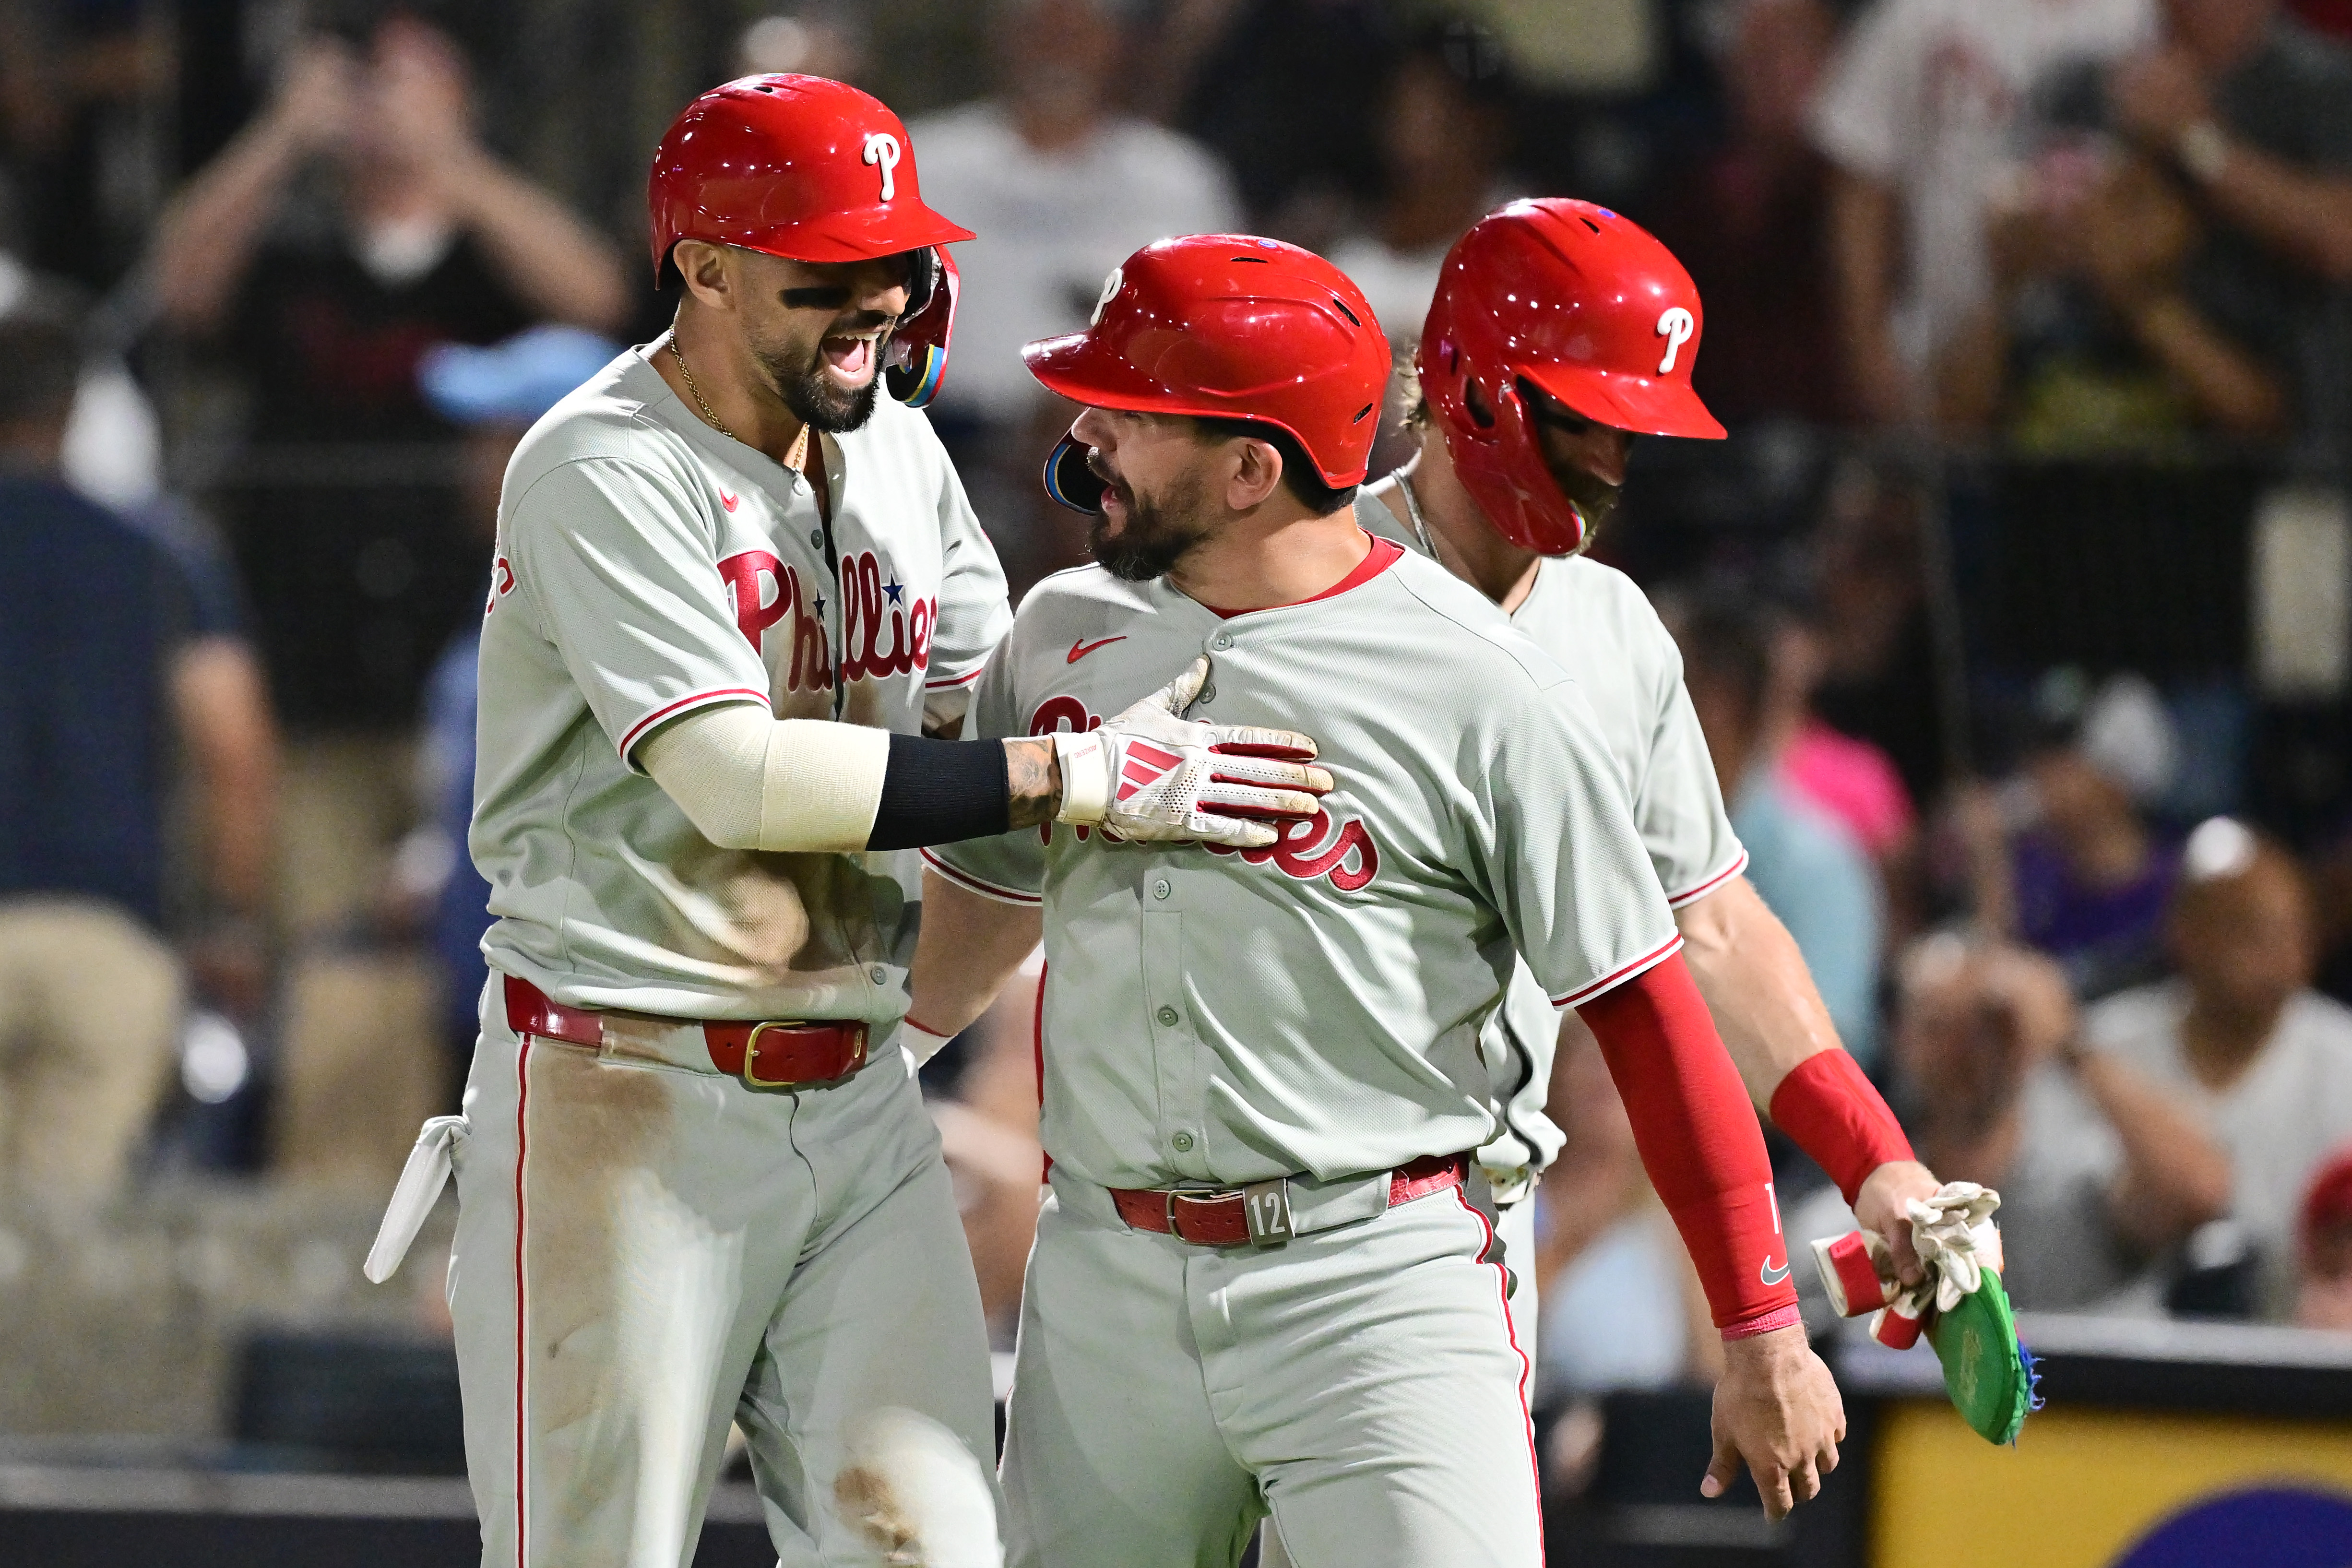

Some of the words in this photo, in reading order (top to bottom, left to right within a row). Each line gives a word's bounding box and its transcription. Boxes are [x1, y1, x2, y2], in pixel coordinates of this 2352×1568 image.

[864, 133, 901, 201] P
[1090, 268, 1123, 327] P
[1657, 307, 1694, 374] P
[1074, 744, 1096, 759] ADIZERO
[1250, 1192, 1285, 1236] 12
